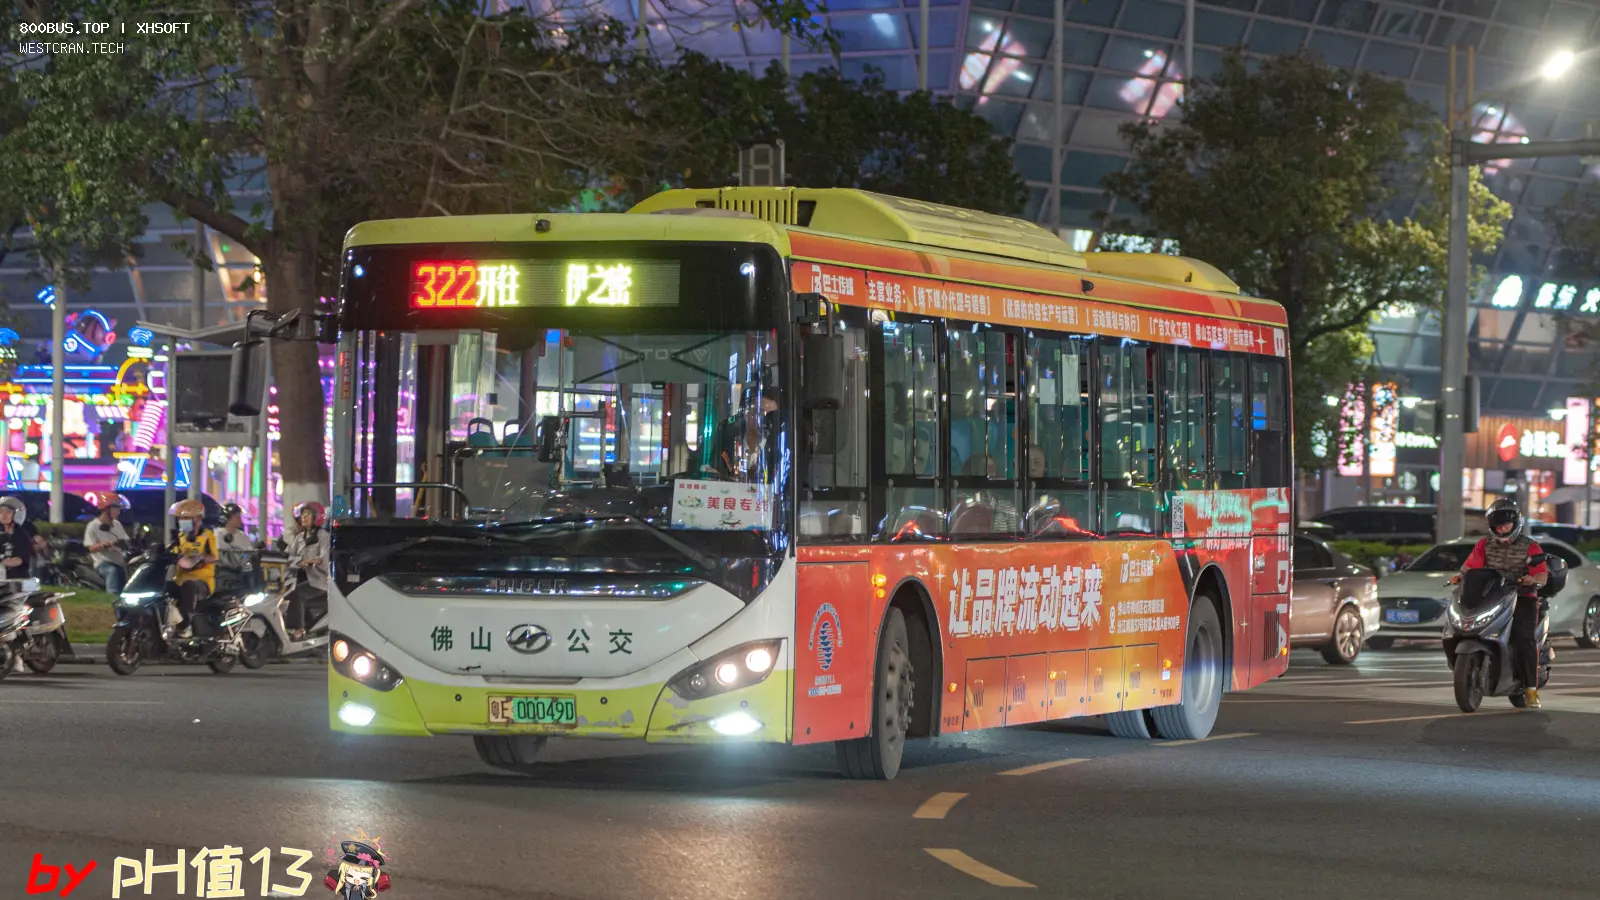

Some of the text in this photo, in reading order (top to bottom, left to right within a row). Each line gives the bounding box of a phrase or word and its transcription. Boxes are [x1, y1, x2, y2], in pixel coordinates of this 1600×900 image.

[823, 274, 854, 296] 巴士传媒
[949, 563, 1102, 636] 让品牌流动起来
[430, 626, 633, 655] 佛山 公交
